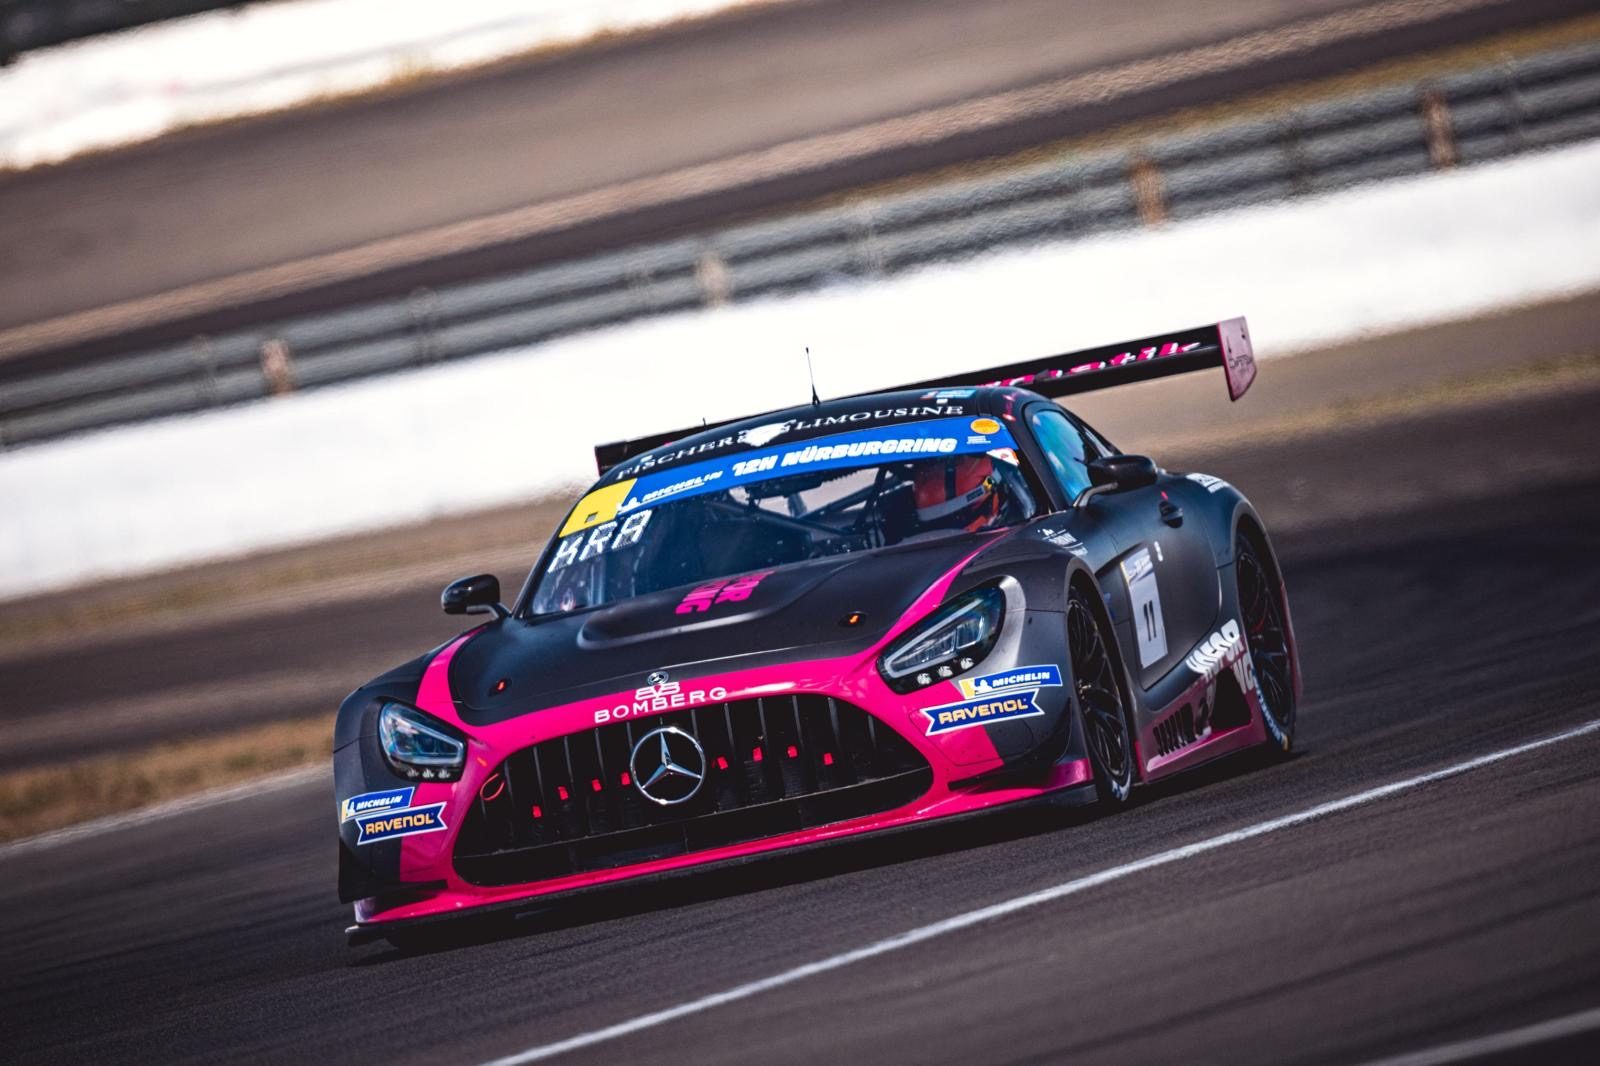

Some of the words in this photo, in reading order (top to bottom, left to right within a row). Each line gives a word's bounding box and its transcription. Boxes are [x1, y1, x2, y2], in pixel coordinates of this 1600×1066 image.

[616, 436, 733, 480] FISCHER
[795, 405, 964, 430] LIMOUSINE
[643, 471, 724, 501] MICHELIN
[732, 455, 778, 477] 12H
[781, 437, 958, 467] NÜRBURGRING
[1143, 599, 1158, 643] 11
[992, 671, 1051, 688] MICHELIN
[594, 686, 728, 724] BOMBERG
[938, 698, 1029, 725] RAVENOL
[355, 795, 403, 811] MICHELIN
[365, 812, 435, 835] RAVENOL
